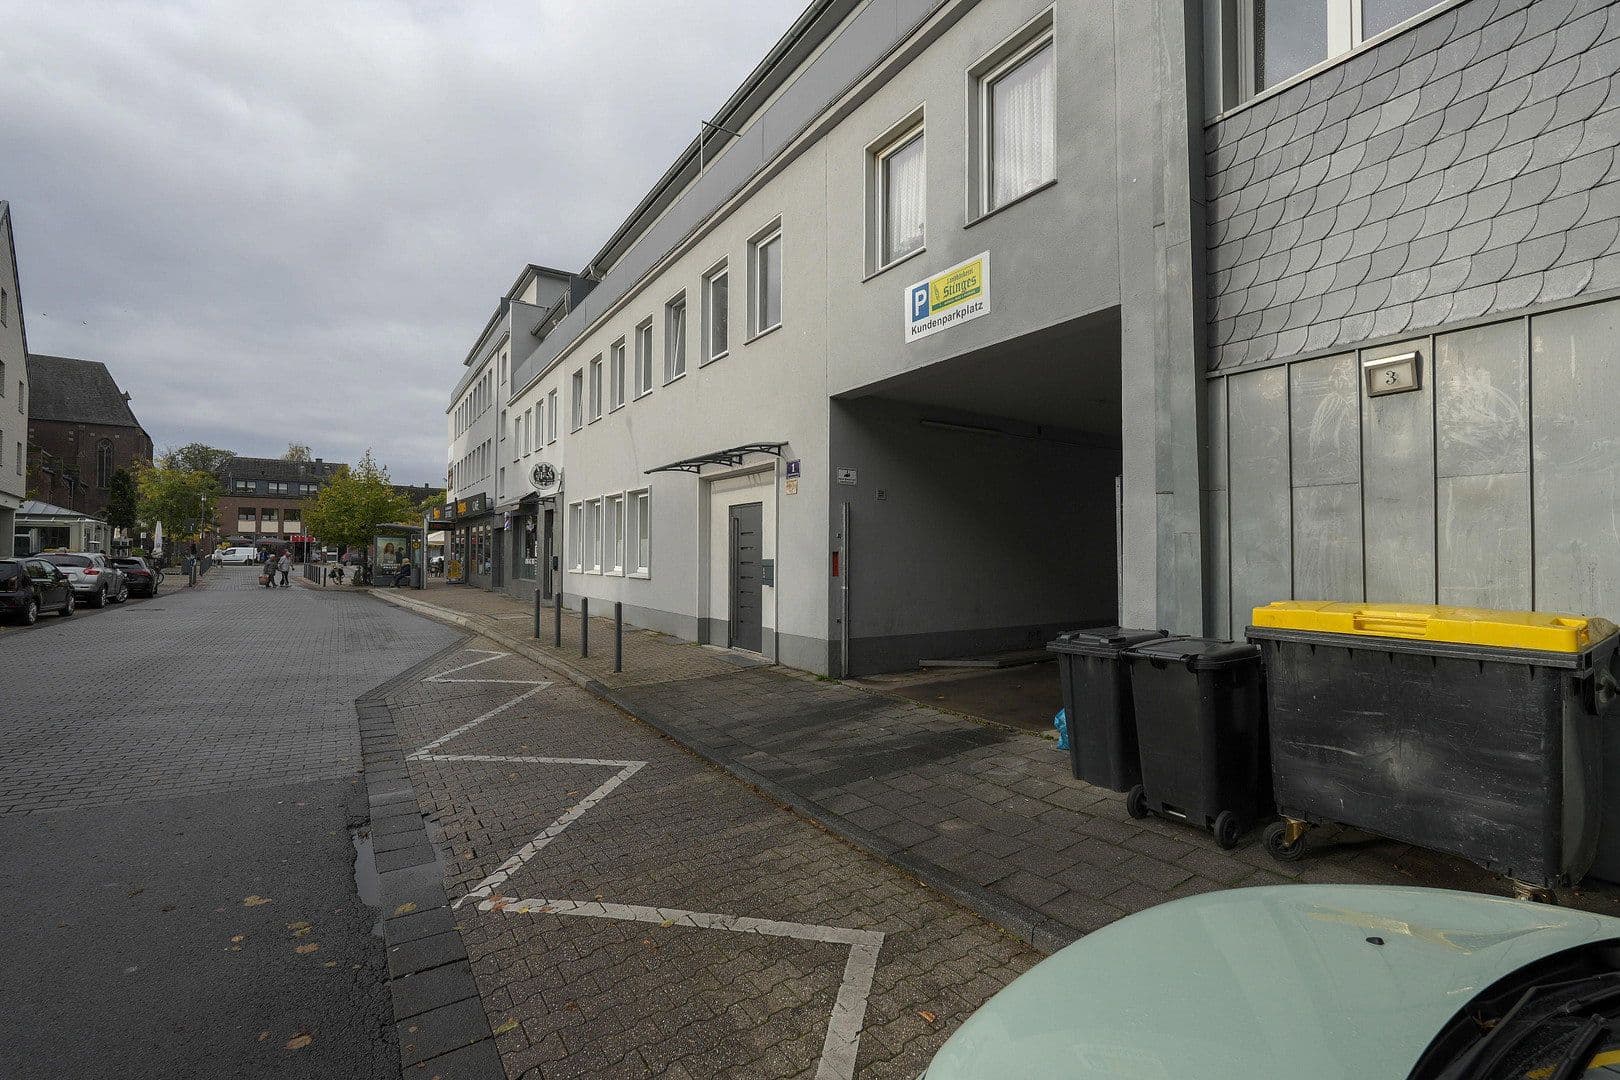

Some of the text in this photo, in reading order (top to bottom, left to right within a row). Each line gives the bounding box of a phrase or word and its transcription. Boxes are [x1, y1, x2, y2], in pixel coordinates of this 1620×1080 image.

[943, 275, 977, 299] Stinges
[915, 289, 927, 317] P
[911, 301, 984, 336] Kundenparkplatz
[1385, 370, 1397, 385] 3
